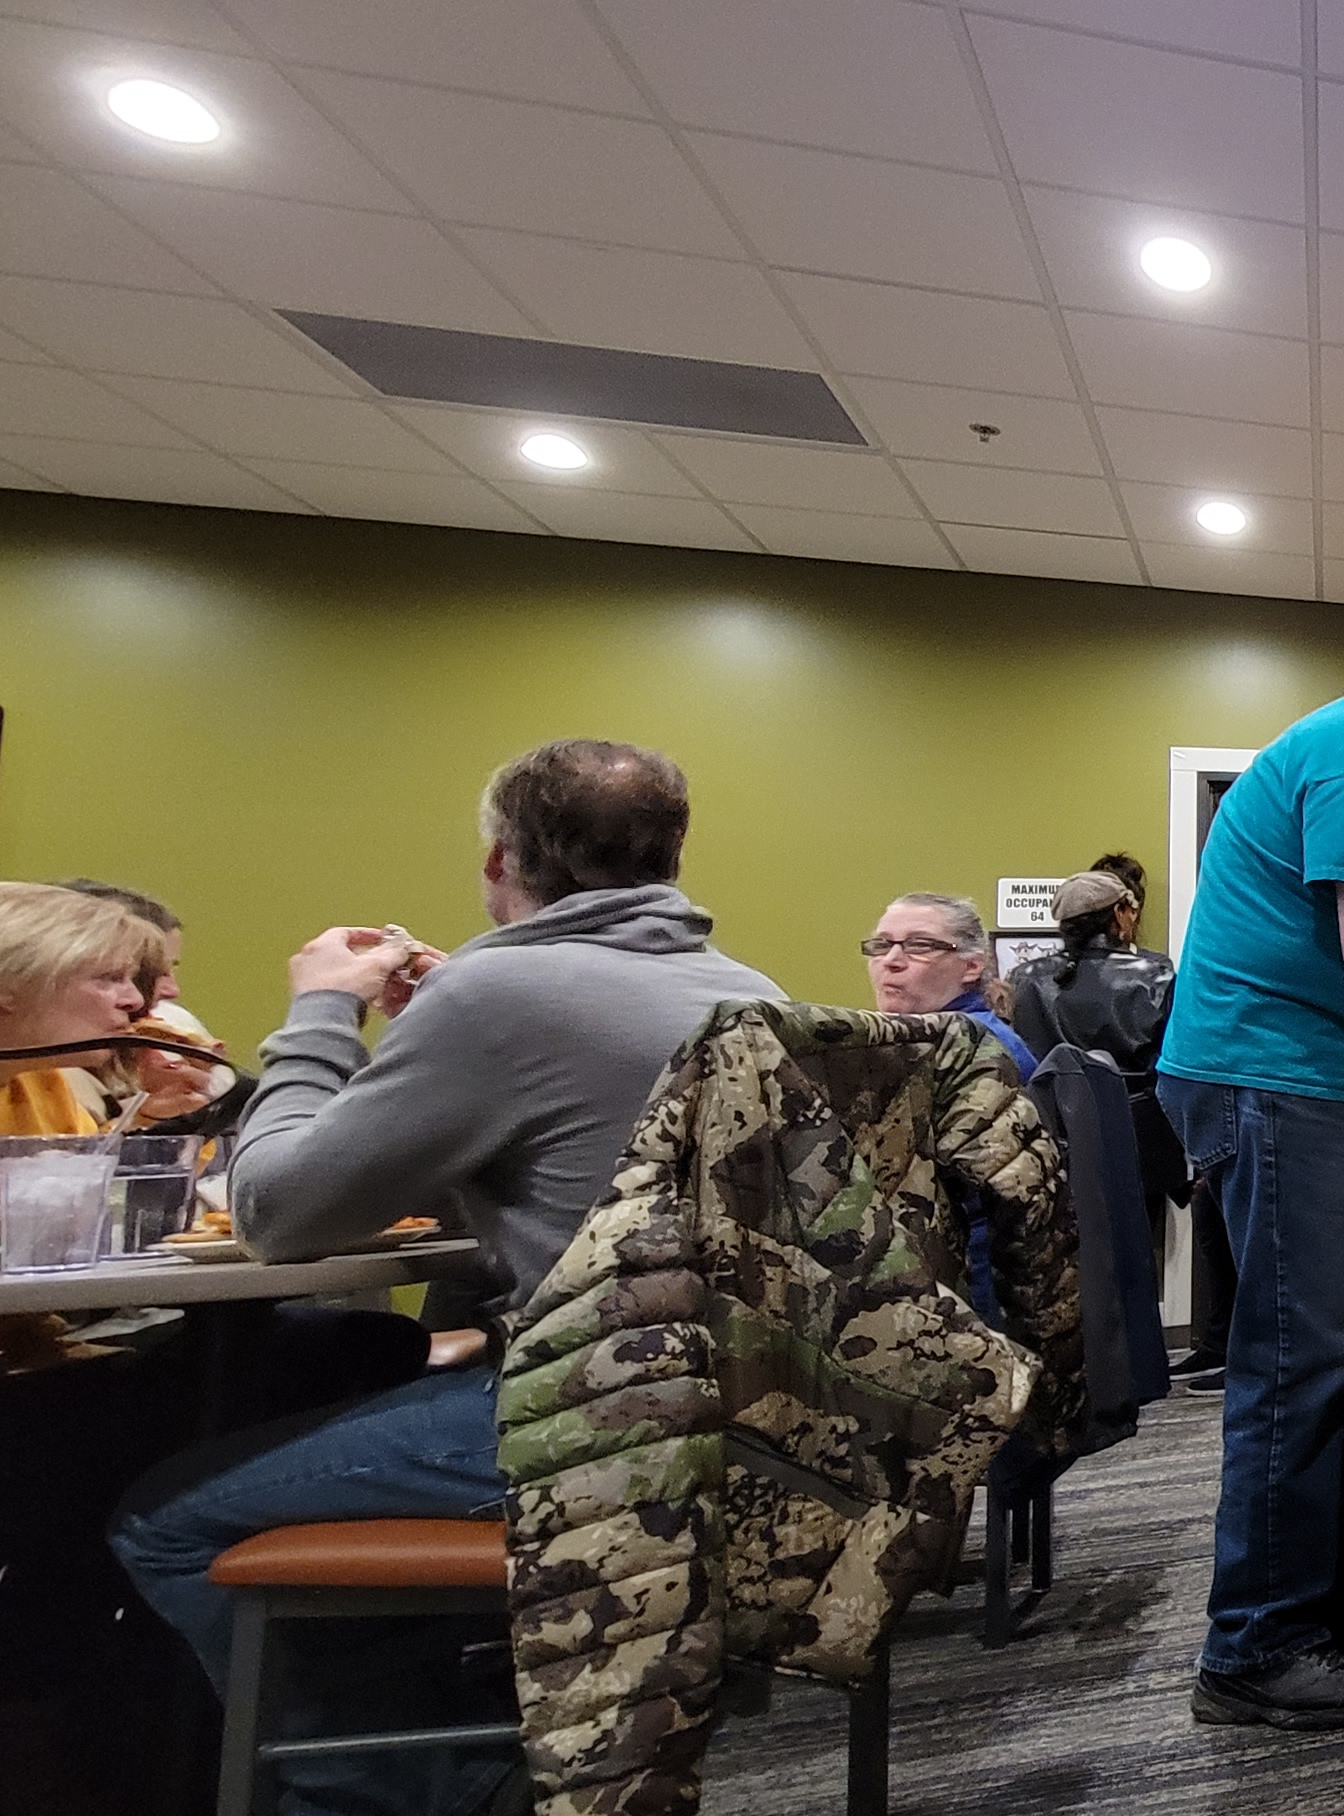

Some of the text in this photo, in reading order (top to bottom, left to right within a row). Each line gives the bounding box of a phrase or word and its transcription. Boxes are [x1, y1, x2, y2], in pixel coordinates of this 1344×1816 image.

[1011, 884, 1059, 895] MAXIMU
[1006, 897, 1053, 908] OCCUPA
[1031, 911, 1044, 921] 64
